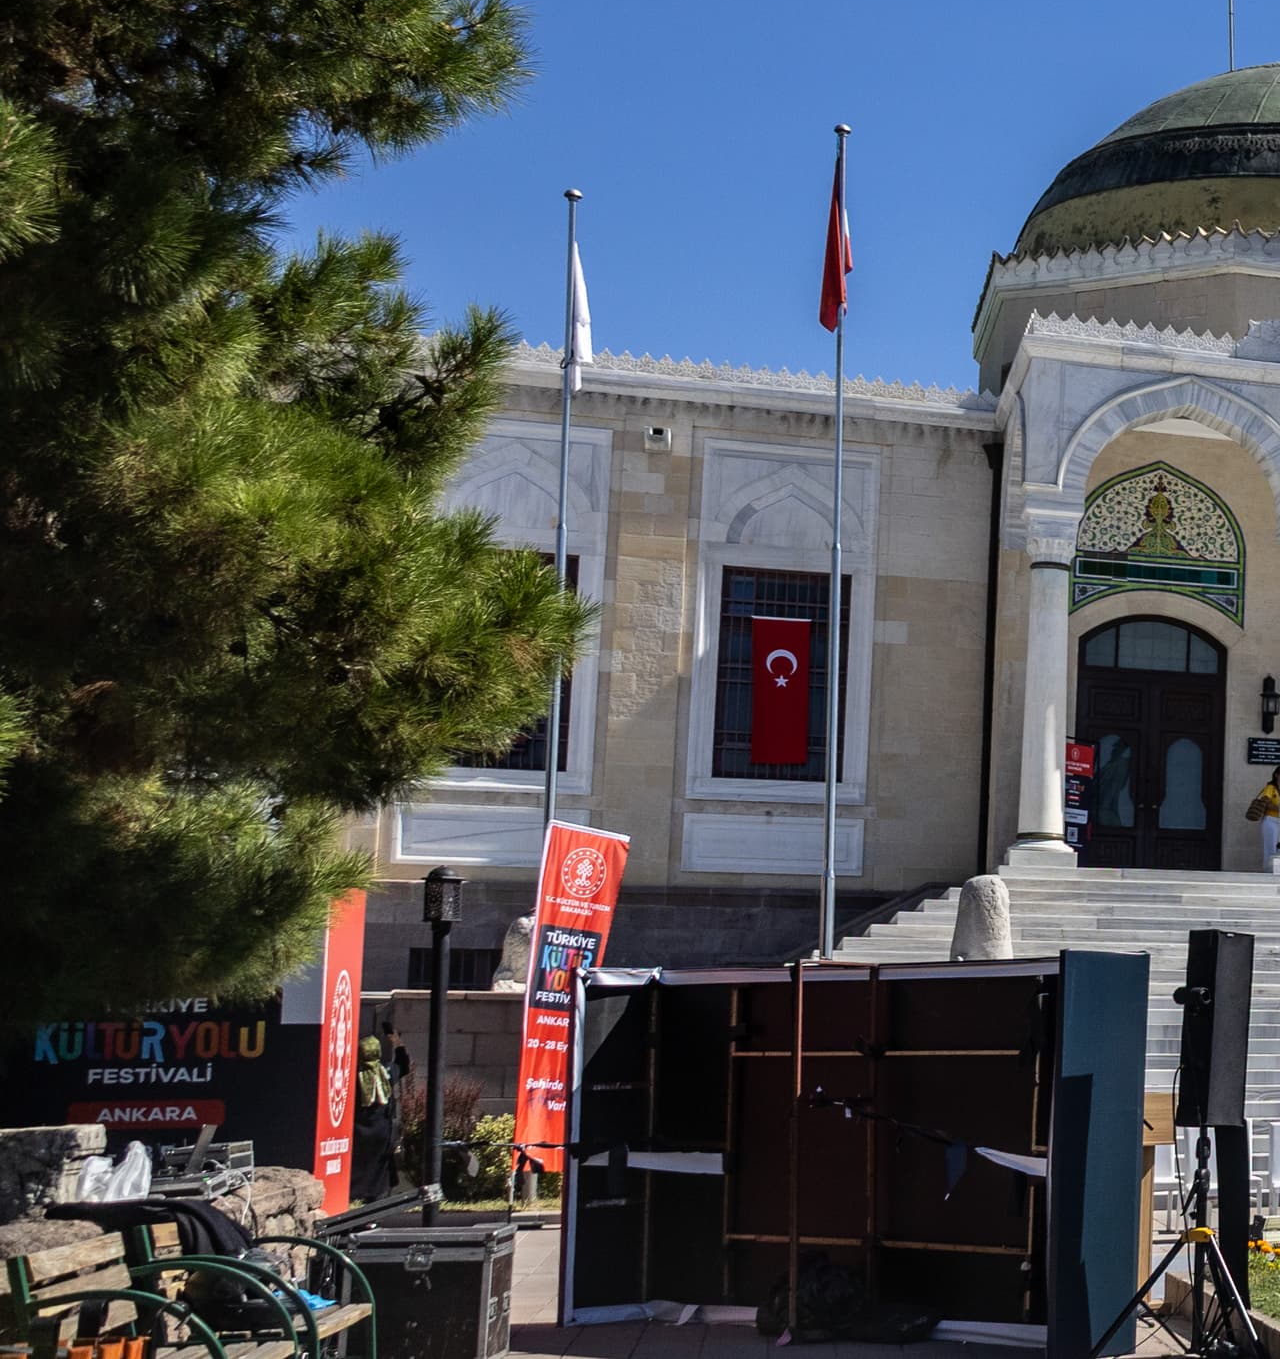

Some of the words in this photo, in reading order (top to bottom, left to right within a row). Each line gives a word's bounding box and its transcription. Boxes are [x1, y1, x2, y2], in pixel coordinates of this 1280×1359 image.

[547, 931, 596, 948] TÜRKİYE
[541, 945, 593, 971] KÜLTÜR
[545, 969, 571, 993] YOL
[535, 991, 571, 1004] FESTİV
[536, 1015, 570, 1027] ANKAR
[34, 1020, 166, 1065] KÜLTÜR
[169, 1020, 266, 1059] YOLU
[527, 1039, 539, 1049] 20
[545, 1040, 556, 1050] 28
[87, 1062, 213, 1085] FESTİVALİ
[526, 1078, 563, 1090] Şehirde
[96, 1104, 198, 1123] ANKARA
[548, 1101, 566, 1111] Var!
